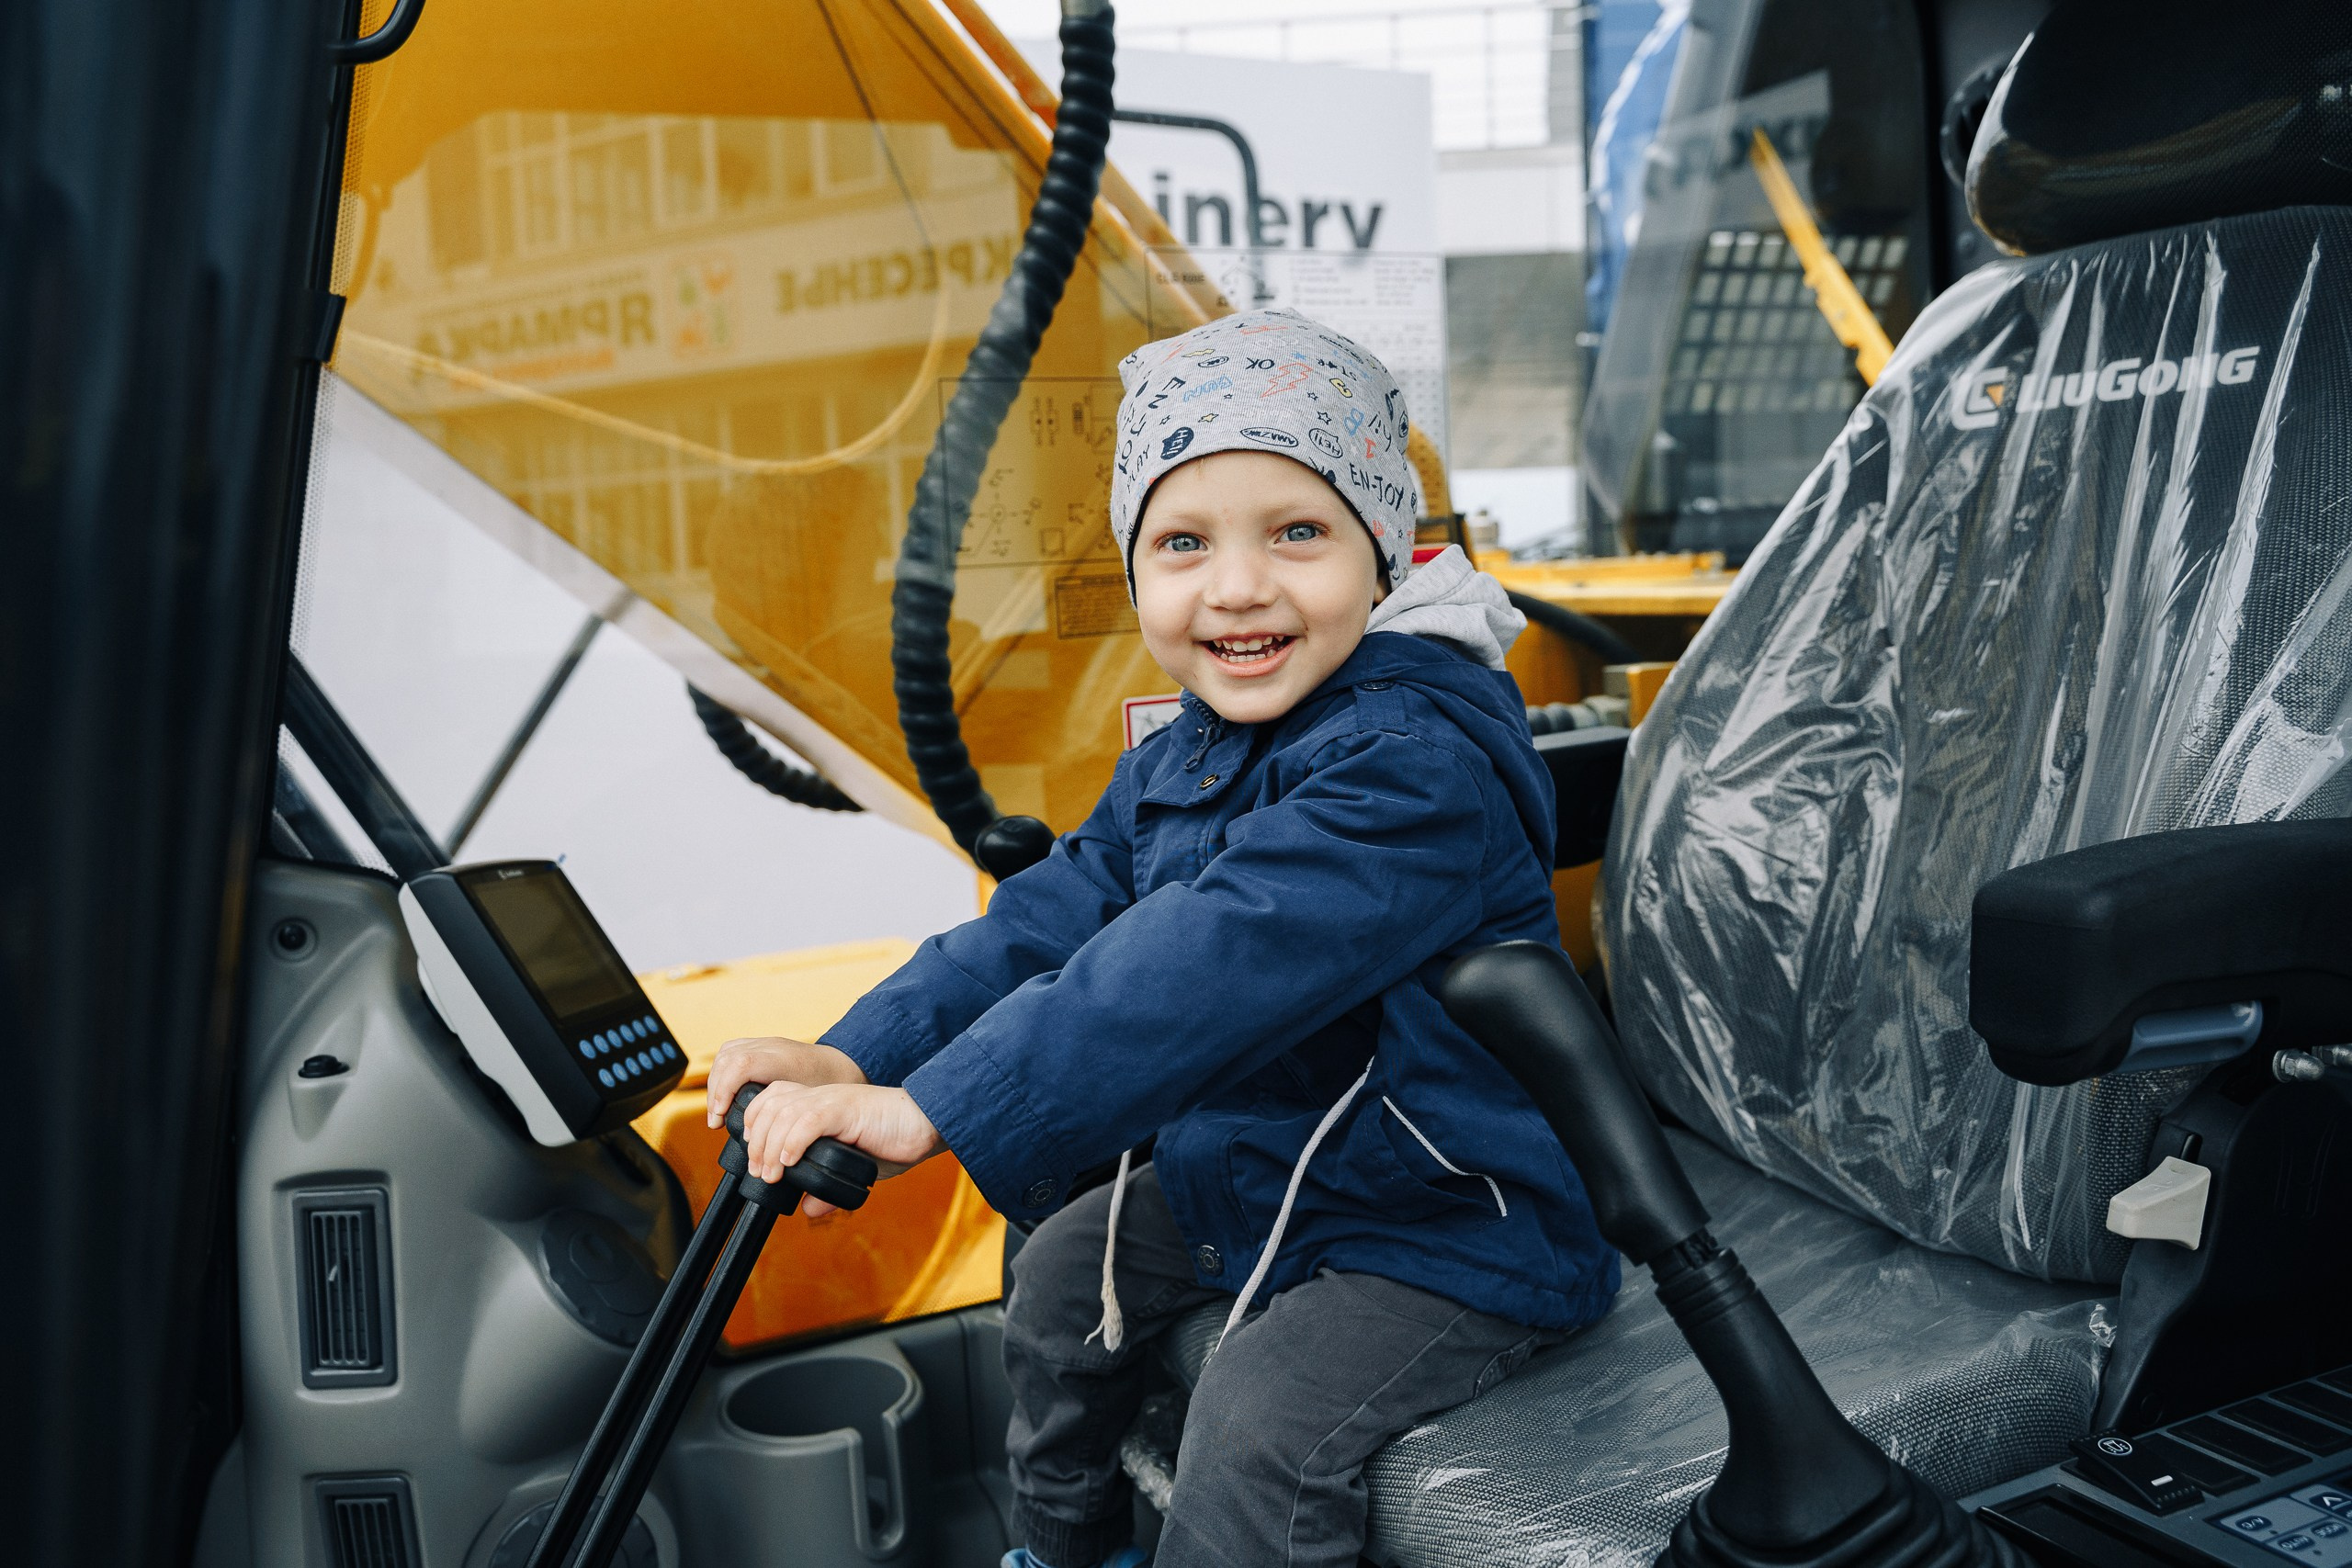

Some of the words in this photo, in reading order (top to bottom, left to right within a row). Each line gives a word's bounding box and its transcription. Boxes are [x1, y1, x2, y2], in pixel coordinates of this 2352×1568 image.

[1245, 356, 1275, 371] OK
[1316, 429, 1341, 456] HEY!
[1349, 462, 1405, 512] EN-JOY
